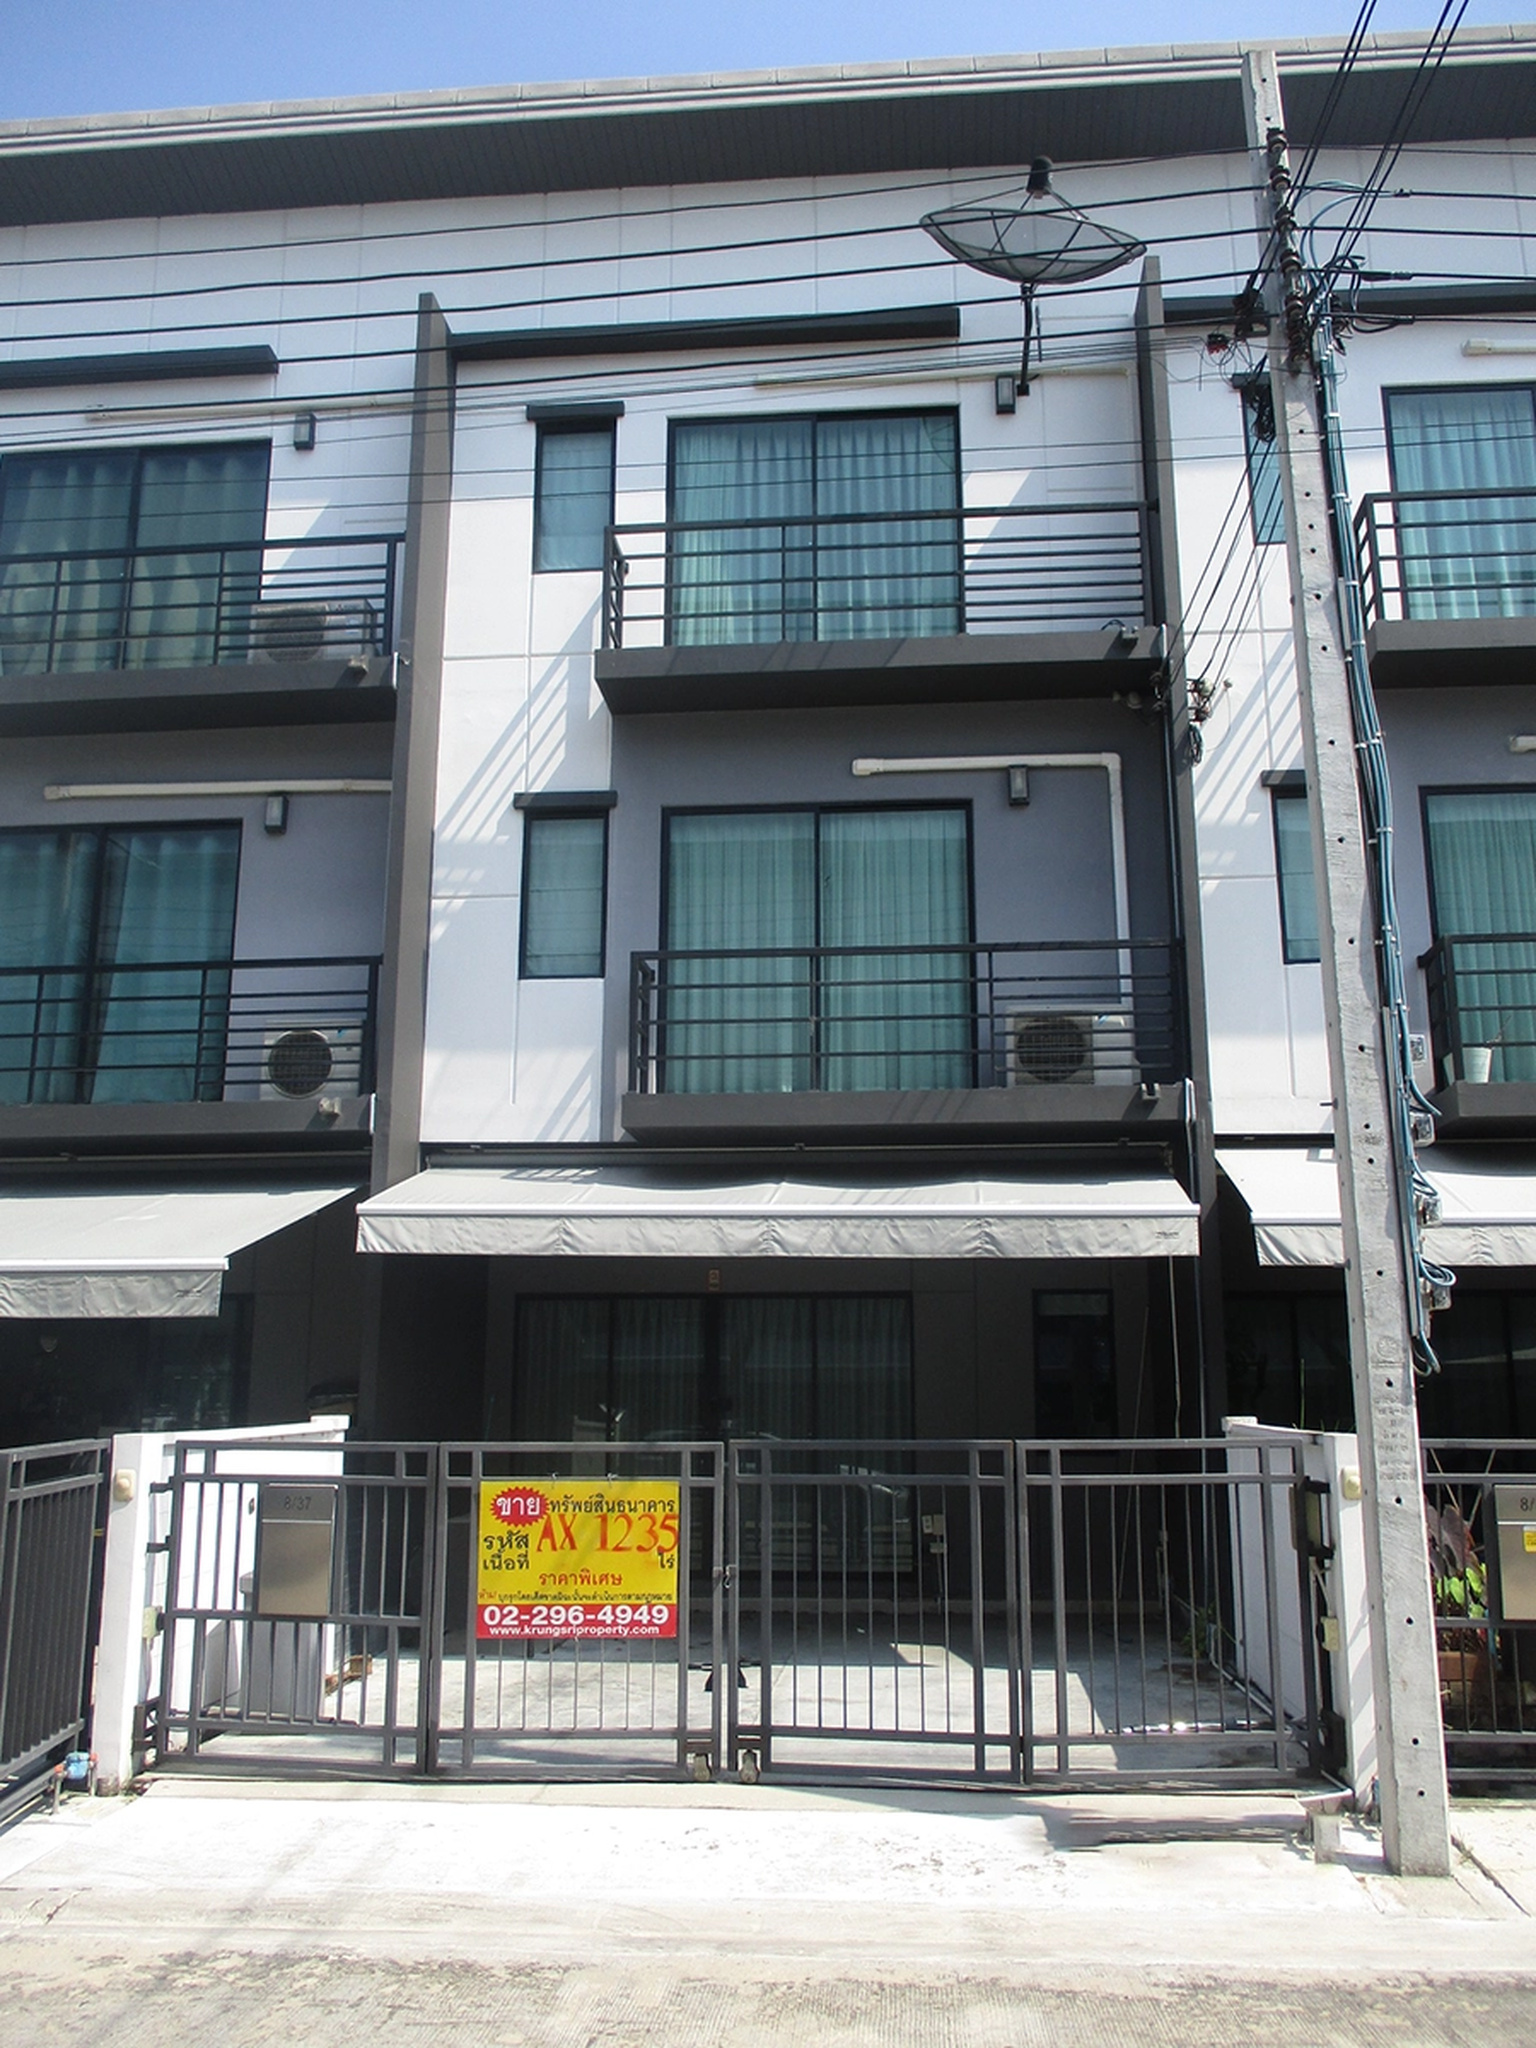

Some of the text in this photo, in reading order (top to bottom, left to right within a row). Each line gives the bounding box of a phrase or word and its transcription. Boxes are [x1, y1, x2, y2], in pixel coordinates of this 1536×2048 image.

[284, 1496, 312, 1511] 8/37
[496, 1493, 675, 1516] ขาย ทรัพย์สินธนาคาร
[483, 1513, 680, 1553] รหัส AX 1235
[483, 1550, 675, 1571] เนื้อที่ ไร่
[539, 1568, 622, 1586] ราคาพิเศษ
[483, 1605, 669, 1625] 02-296-4949
[489, 1624, 660, 1637] www.krungsriproperty.com
